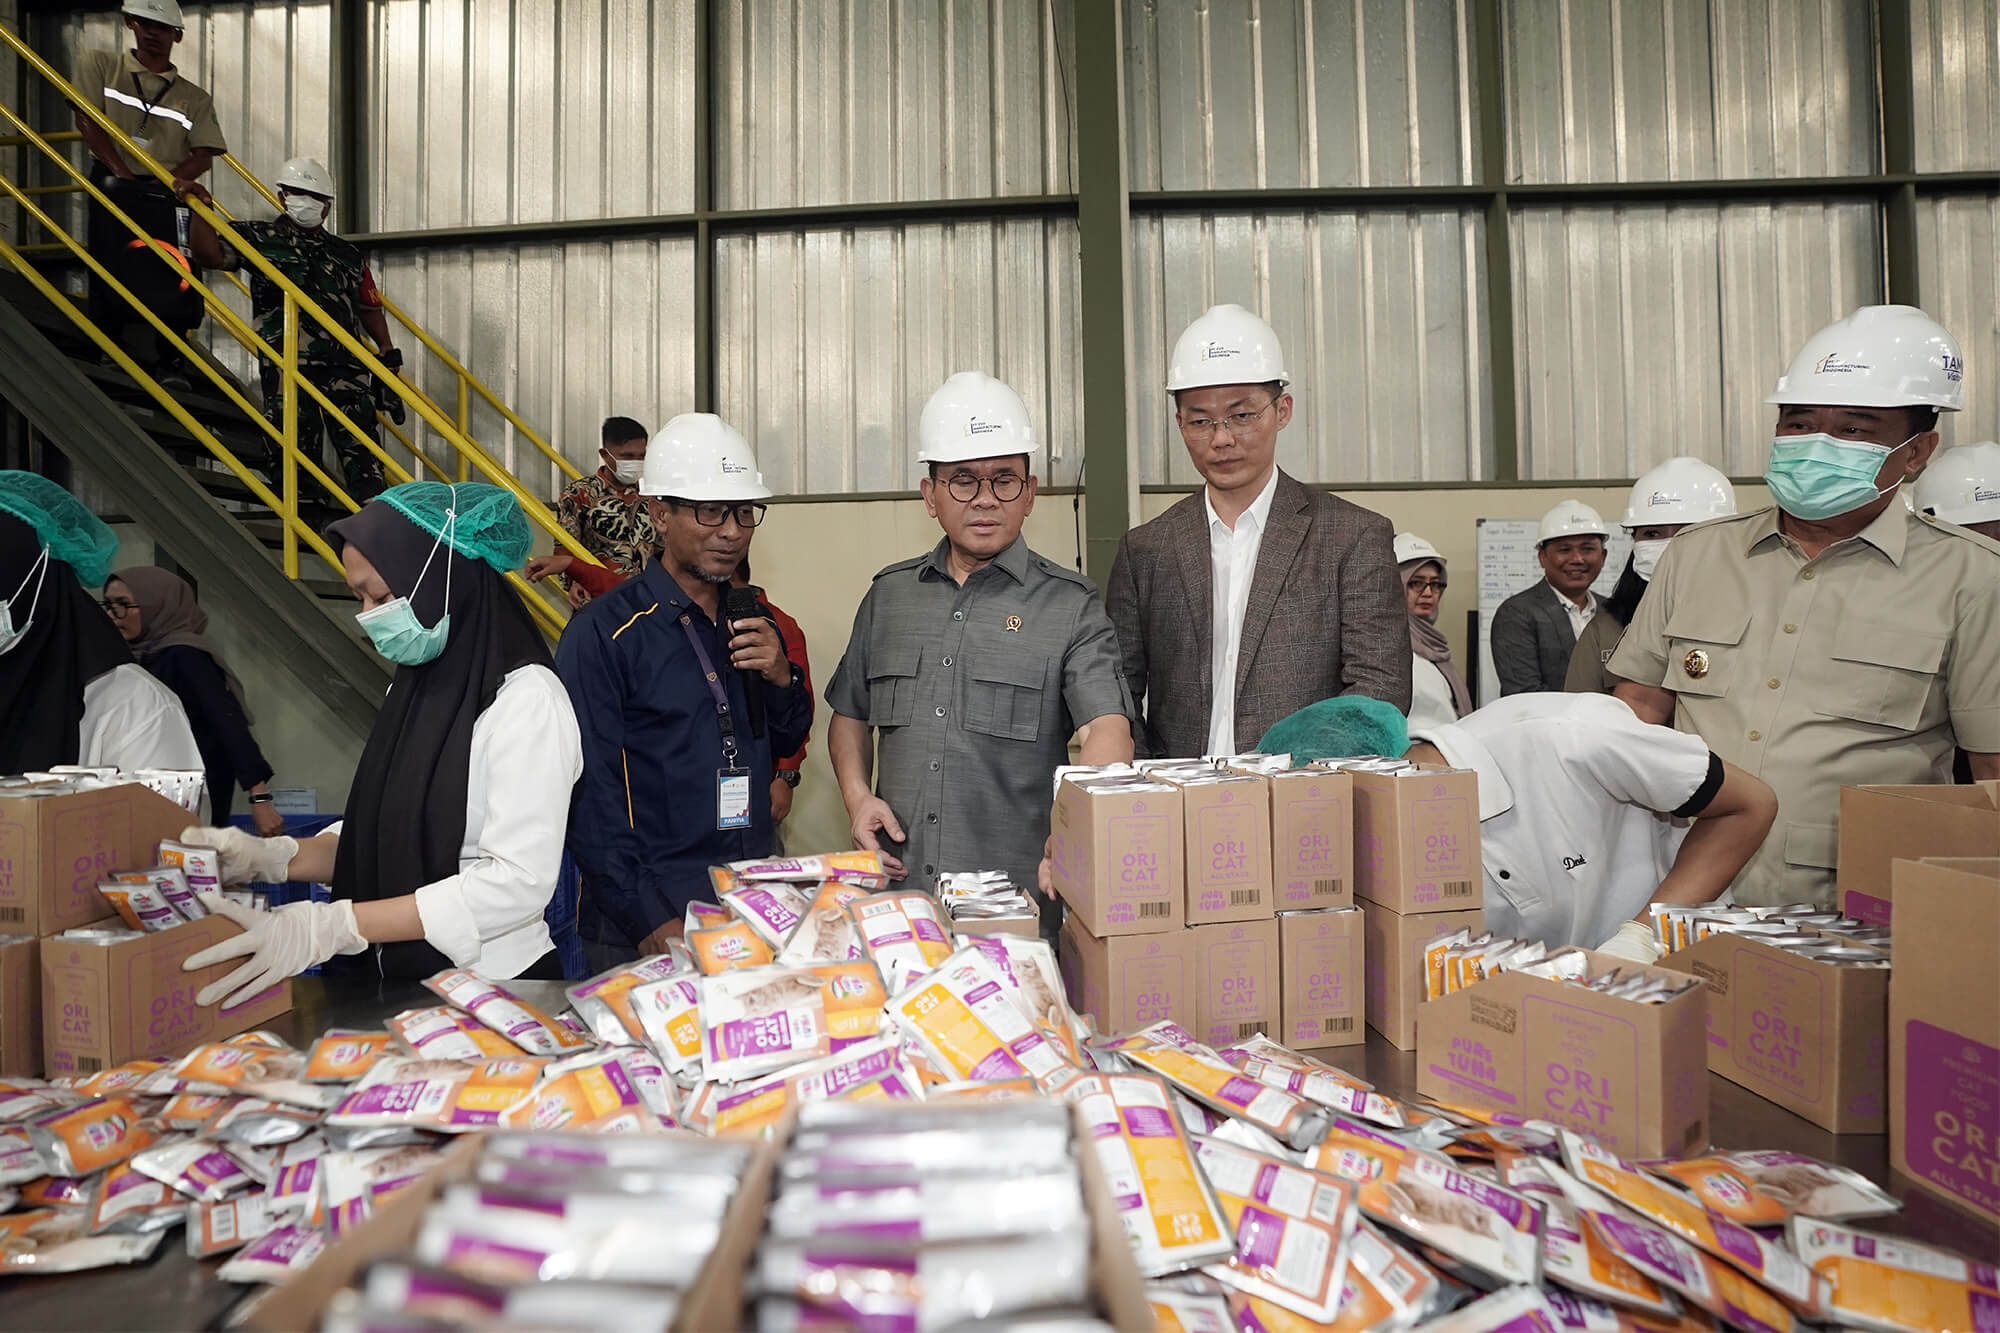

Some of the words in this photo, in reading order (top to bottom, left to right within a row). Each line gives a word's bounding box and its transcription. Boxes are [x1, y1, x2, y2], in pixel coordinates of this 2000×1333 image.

[1212, 840, 1246, 856] ORI
[1299, 834, 1330, 848] ORI
[1425, 833, 1457, 848] ORI
[72, 849, 118, 874] ORI
[1122, 852, 1157, 867] ORI
[1211, 855, 1248, 871] CAT
[1297, 847, 1333, 863] CAT
[1424, 848, 1459, 863] CAT
[1121, 867, 1159, 882] CAT
[1221, 975, 1255, 991] ORI
[1308, 972, 1341, 987] ORI
[150, 984, 196, 1017] ORI
[1136, 991, 1171, 1007] ORI
[1220, 990, 1257, 1006] CAT
[1307, 985, 1343, 1001] CAT
[63, 1003, 89, 1019] ORI
[1135, 1005, 1172, 1022] CAT
[62, 1018, 92, 1034] CAT
[149, 1003, 200, 1037] CAT
[1752, 1010, 1800, 1046] ORI
[755, 1016, 766, 1048] ORI
[766, 1016, 780, 1048] CAT
[1750, 1032, 1803, 1069] CAT
[1546, 1063, 1609, 1101] ORI
[1544, 1087, 1615, 1125] CAT
[1931, 1135, 2000, 1187] CAT
